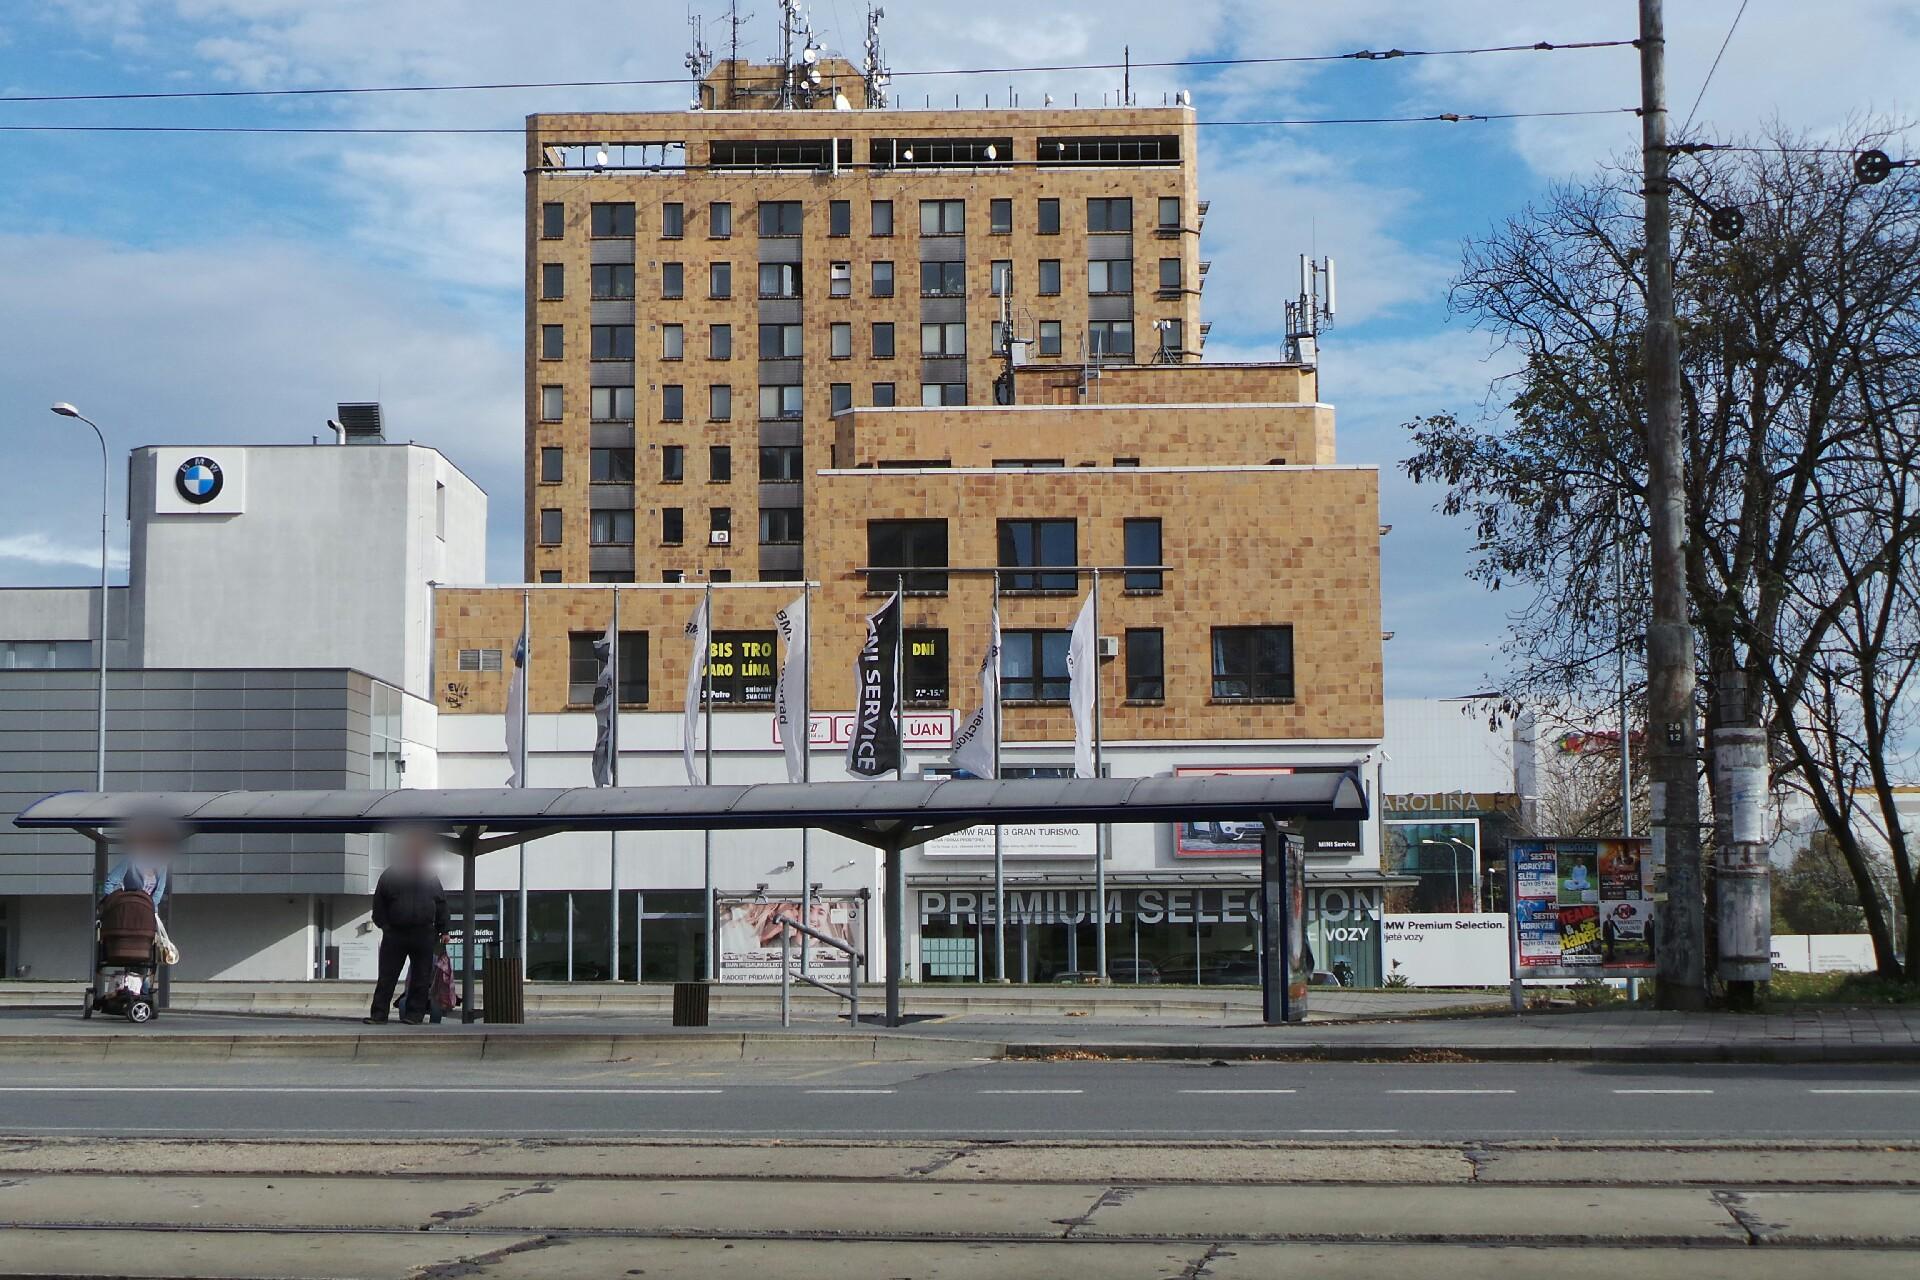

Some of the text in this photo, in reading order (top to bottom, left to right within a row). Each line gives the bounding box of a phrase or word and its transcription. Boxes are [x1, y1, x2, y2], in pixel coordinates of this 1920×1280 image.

[180, 458, 220, 473] BMW
[710, 642, 772, 658] BIS TRO
[912, 640, 935, 656] DNÍ
[741, 660, 771, 677] LÍNA
[711, 690, 731, 699] Patro
[858, 669, 881, 770] SERVICE
[1667, 723, 1681, 731] 26
[1668, 733, 1681, 741] 12
[1382, 793, 1480, 812] AROLINA
[1011, 828, 1036, 836] GRAN
[921, 888, 1380, 925] PREMIUM SELEION
[1408, 920, 1453, 930] Premium
[1454, 920, 1506, 930] Selection.
[1325, 927, 1370, 941] VOZY
[1404, 934, 1424, 943] vozy
